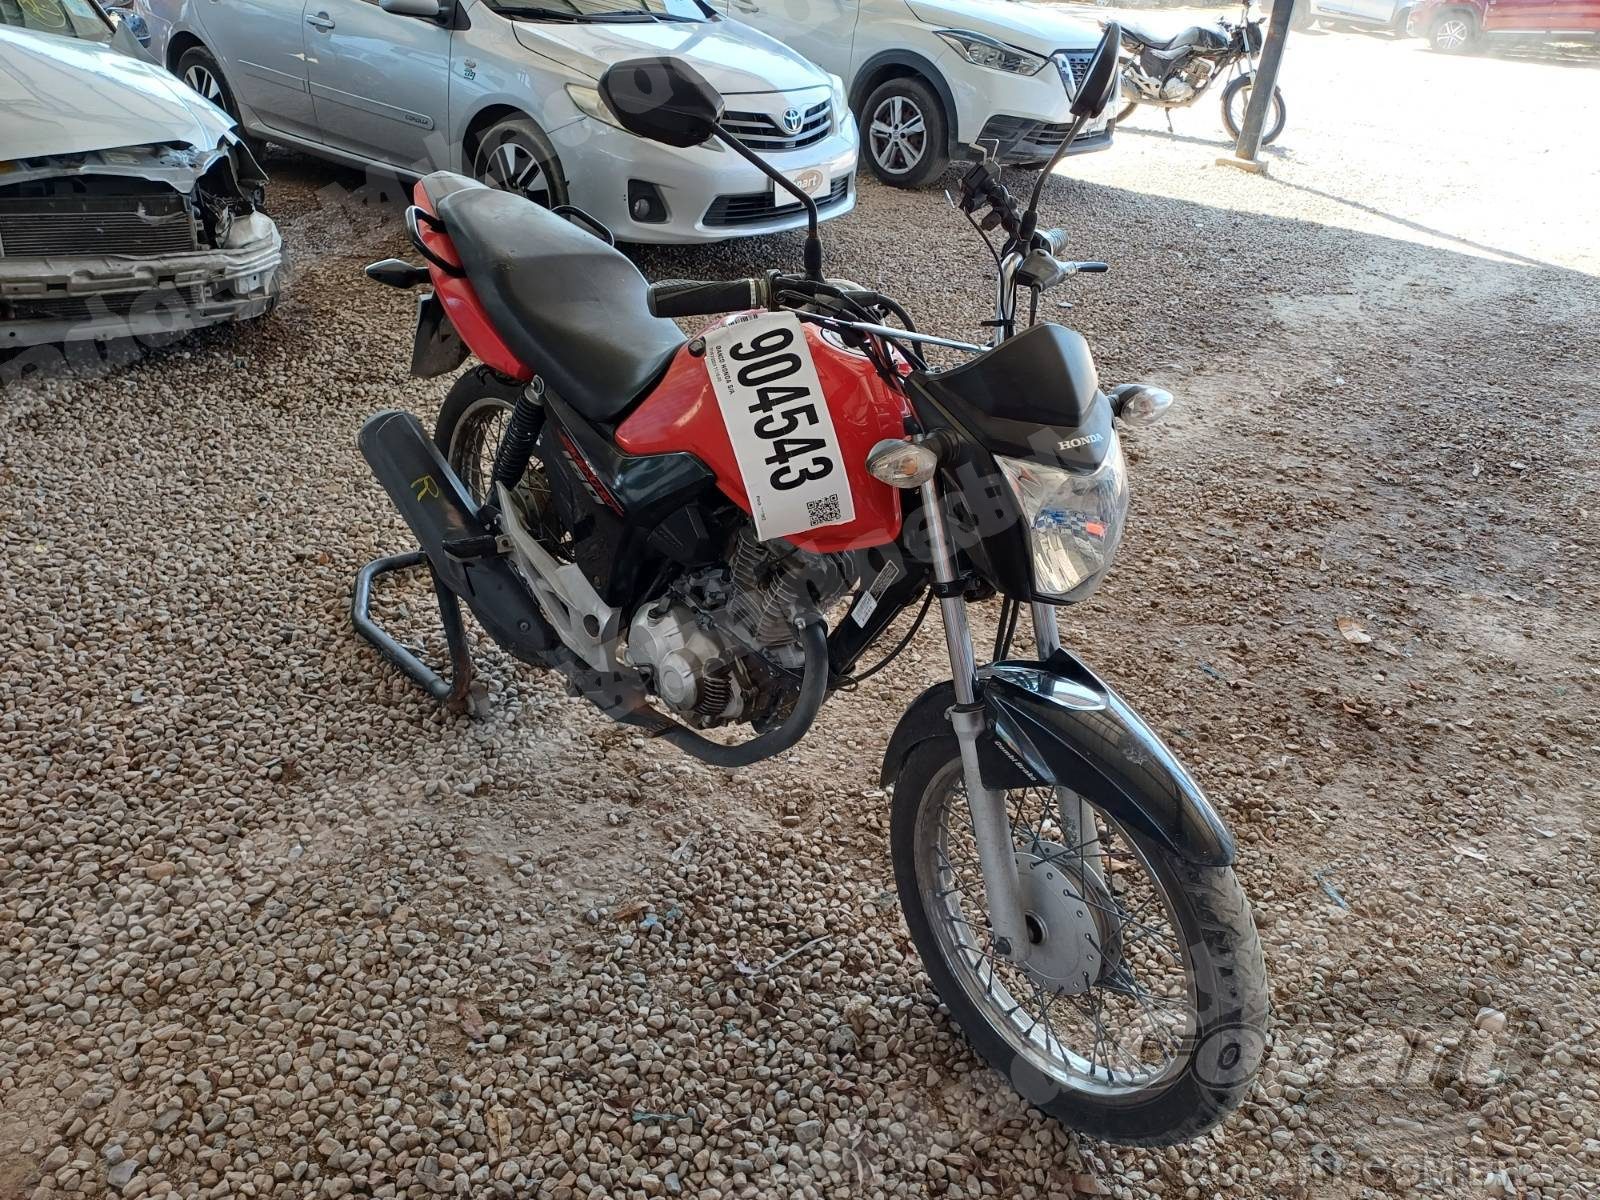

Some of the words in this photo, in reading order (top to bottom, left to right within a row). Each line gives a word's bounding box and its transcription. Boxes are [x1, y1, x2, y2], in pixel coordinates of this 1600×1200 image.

[715, 345, 726, 363] BANCO
[720, 363, 732, 384] HONDA
[727, 384, 735, 395] S/A
[729, 327, 833, 491] 904543
[1057, 433, 1104, 450] HONDA
[993, 740, 1018, 762] Combi
[1014, 761, 1038, 782] Brake
